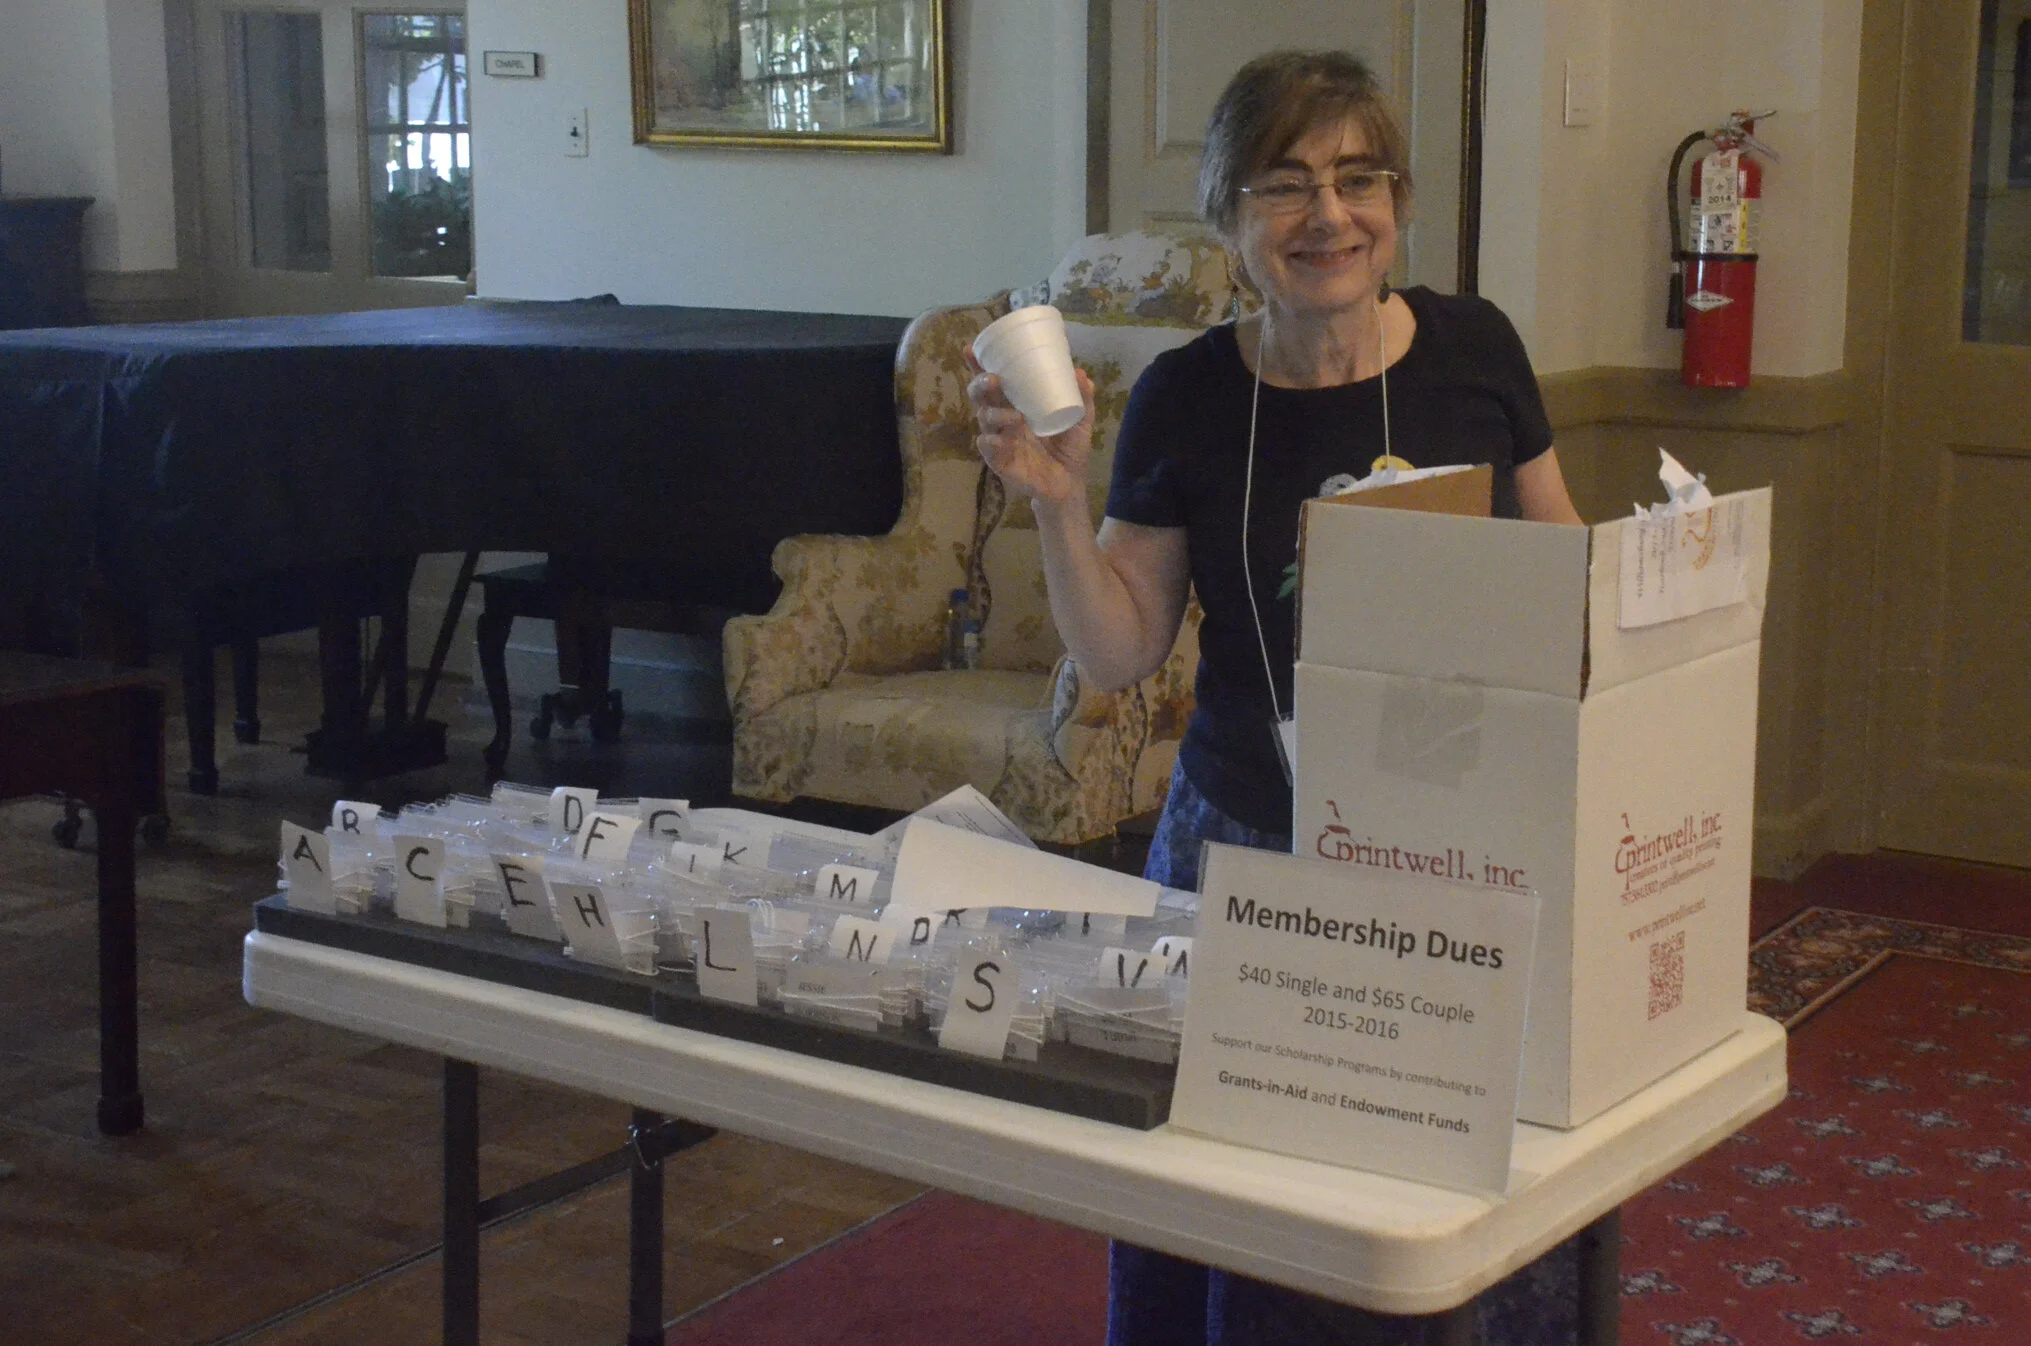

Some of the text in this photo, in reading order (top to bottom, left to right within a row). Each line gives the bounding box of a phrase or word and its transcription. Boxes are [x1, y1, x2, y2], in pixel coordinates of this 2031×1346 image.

[564, 794, 583, 835] D
[292, 836, 323, 872] A
[582, 816, 619, 860] F
[724, 841, 748, 865] K
[405, 846, 435, 882] C
[498, 863, 536, 907] E
[829, 873, 857, 901] M
[573, 893, 604, 928] H
[703, 920, 737, 972] L
[846, 929, 878, 962] N
[1226, 895, 1504, 969] Membership Dues
[965, 961, 1000, 1013] S
[1117, 953, 1149, 988] V
[1238, 962, 1475, 1024] $40 Single and $65 Couple
[1303, 1006, 1400, 1040] 2015-2016
[1211, 1032, 1486, 1097] Support our Scholarship Programs by contributing to
[1218, 1070, 1470, 1134] Grants-in-Aid and Endowment Funds
